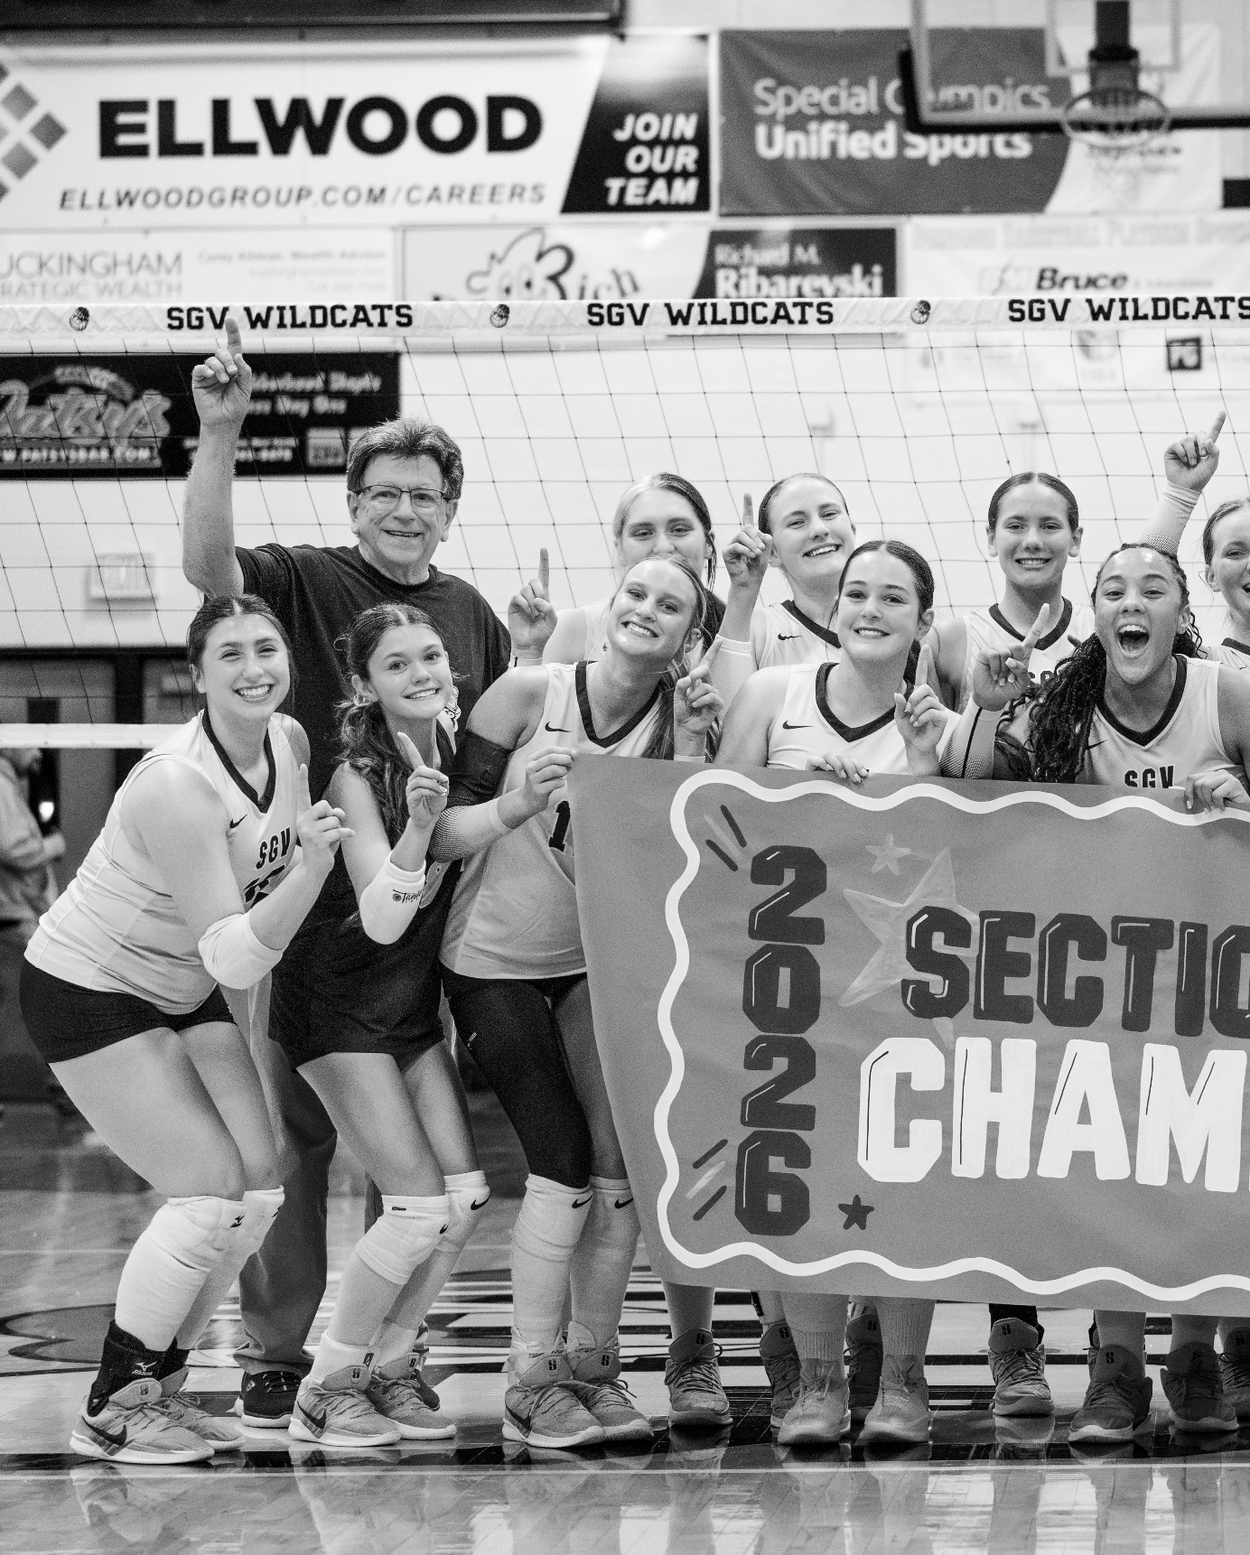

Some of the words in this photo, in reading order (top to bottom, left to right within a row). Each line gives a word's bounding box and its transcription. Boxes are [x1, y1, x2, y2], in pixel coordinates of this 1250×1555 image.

[753, 77, 880, 122] Special
[99, 95, 543, 157] ELLWOOD
[613, 112, 699, 142] JOIN
[755, 120, 898, 160] Unified
[624, 145, 699, 173] OUR
[60, 183, 546, 211] ELLWOODGROUP.COM/CAREERS
[603, 177, 700, 207] TEAM
[1036, 266, 1129, 291] Bruce
[167, 306, 230, 330] SGV
[244, 304, 413, 330] WILDCATS
[587, 302, 650, 326] SGV
[664, 301, 835, 326] WILDCATS
[1008, 298, 1072, 322] SGV
[1124, 764, 1175, 789] SGV
[256, 827, 291, 870] SGV
[735, 844, 828, 1237] 2026
